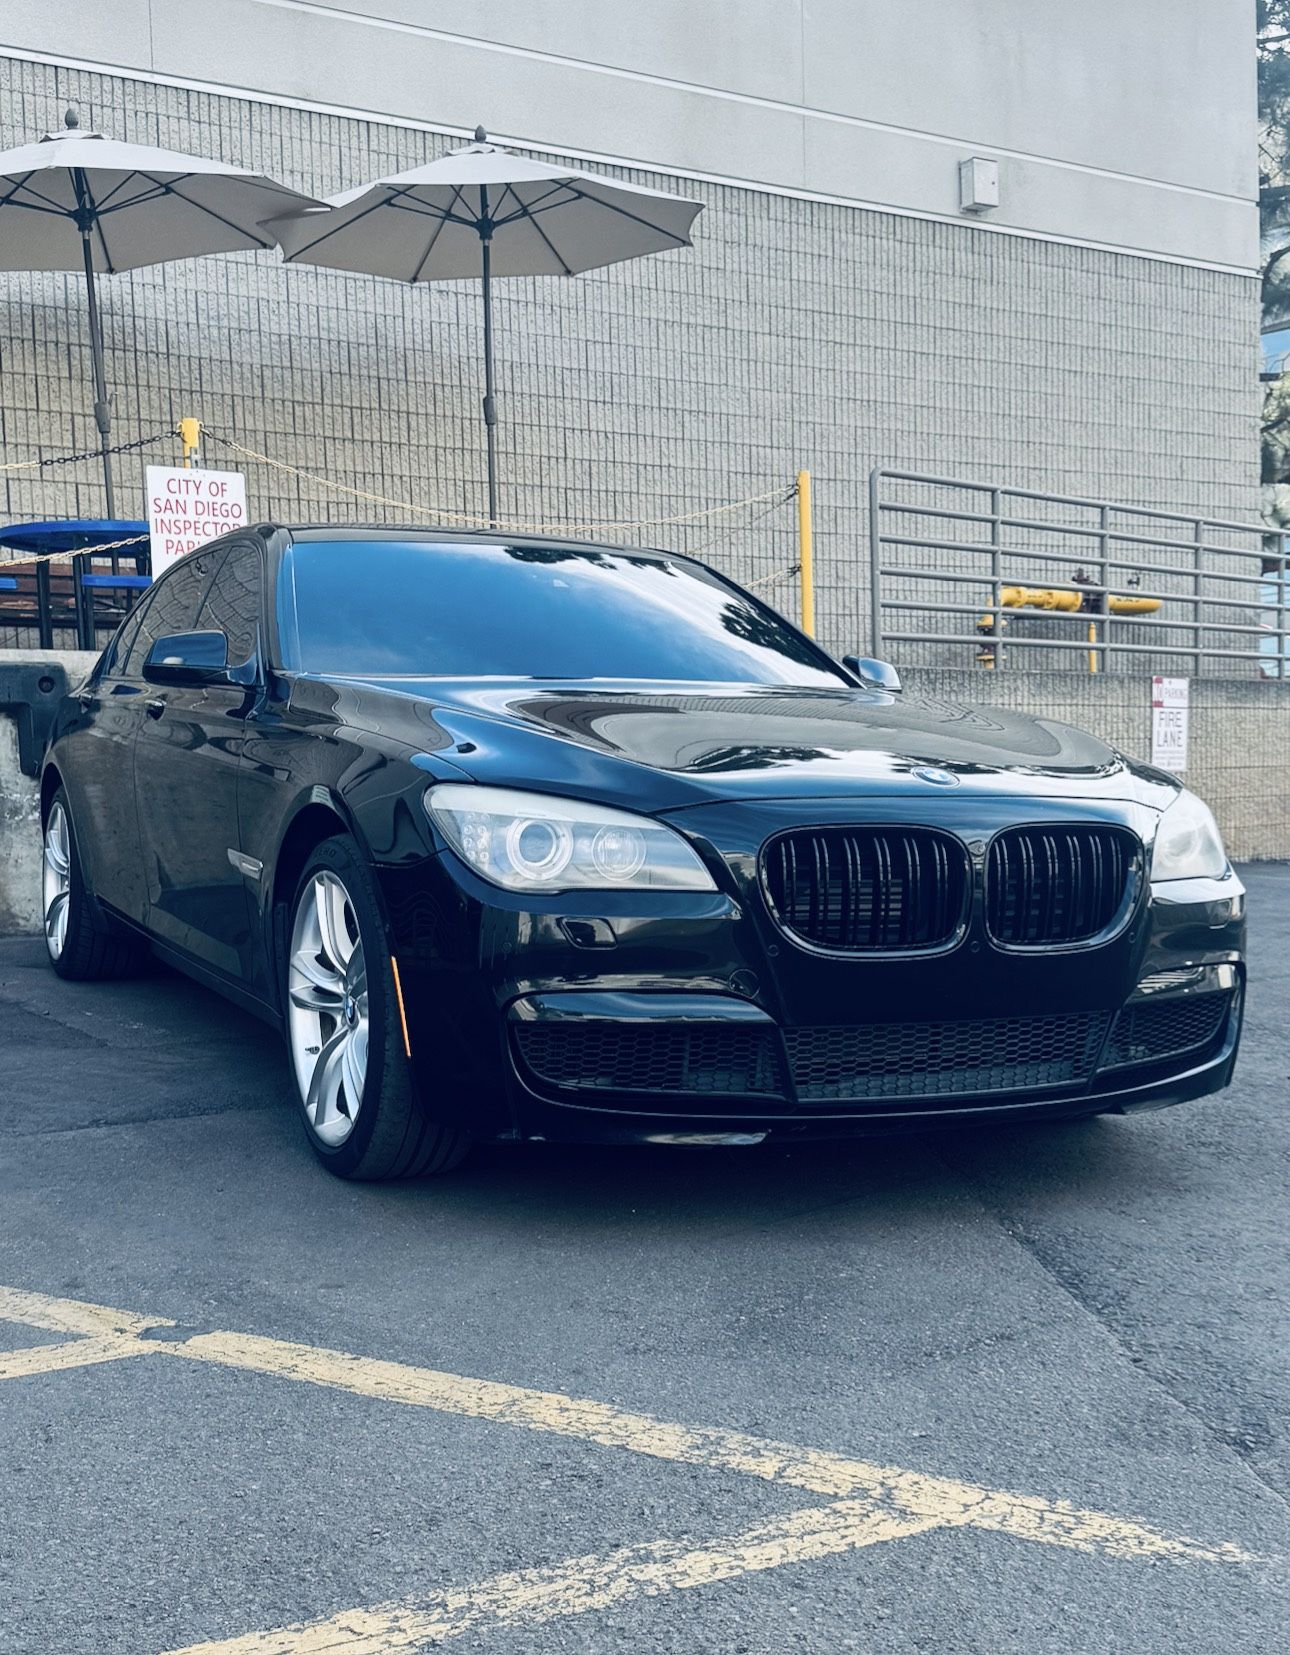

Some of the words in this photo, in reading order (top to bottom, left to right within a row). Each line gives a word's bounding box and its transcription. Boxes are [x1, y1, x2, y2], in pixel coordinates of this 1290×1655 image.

[167, 478, 202, 496] CITY
[208, 481, 228, 498] OF
[153, 497, 188, 515] SAN
[194, 500, 242, 519] DIEGO
[165, 539, 201, 556] PAR
[1159, 711, 1182, 728] FIRE
[1157, 730, 1183, 748] LANE
